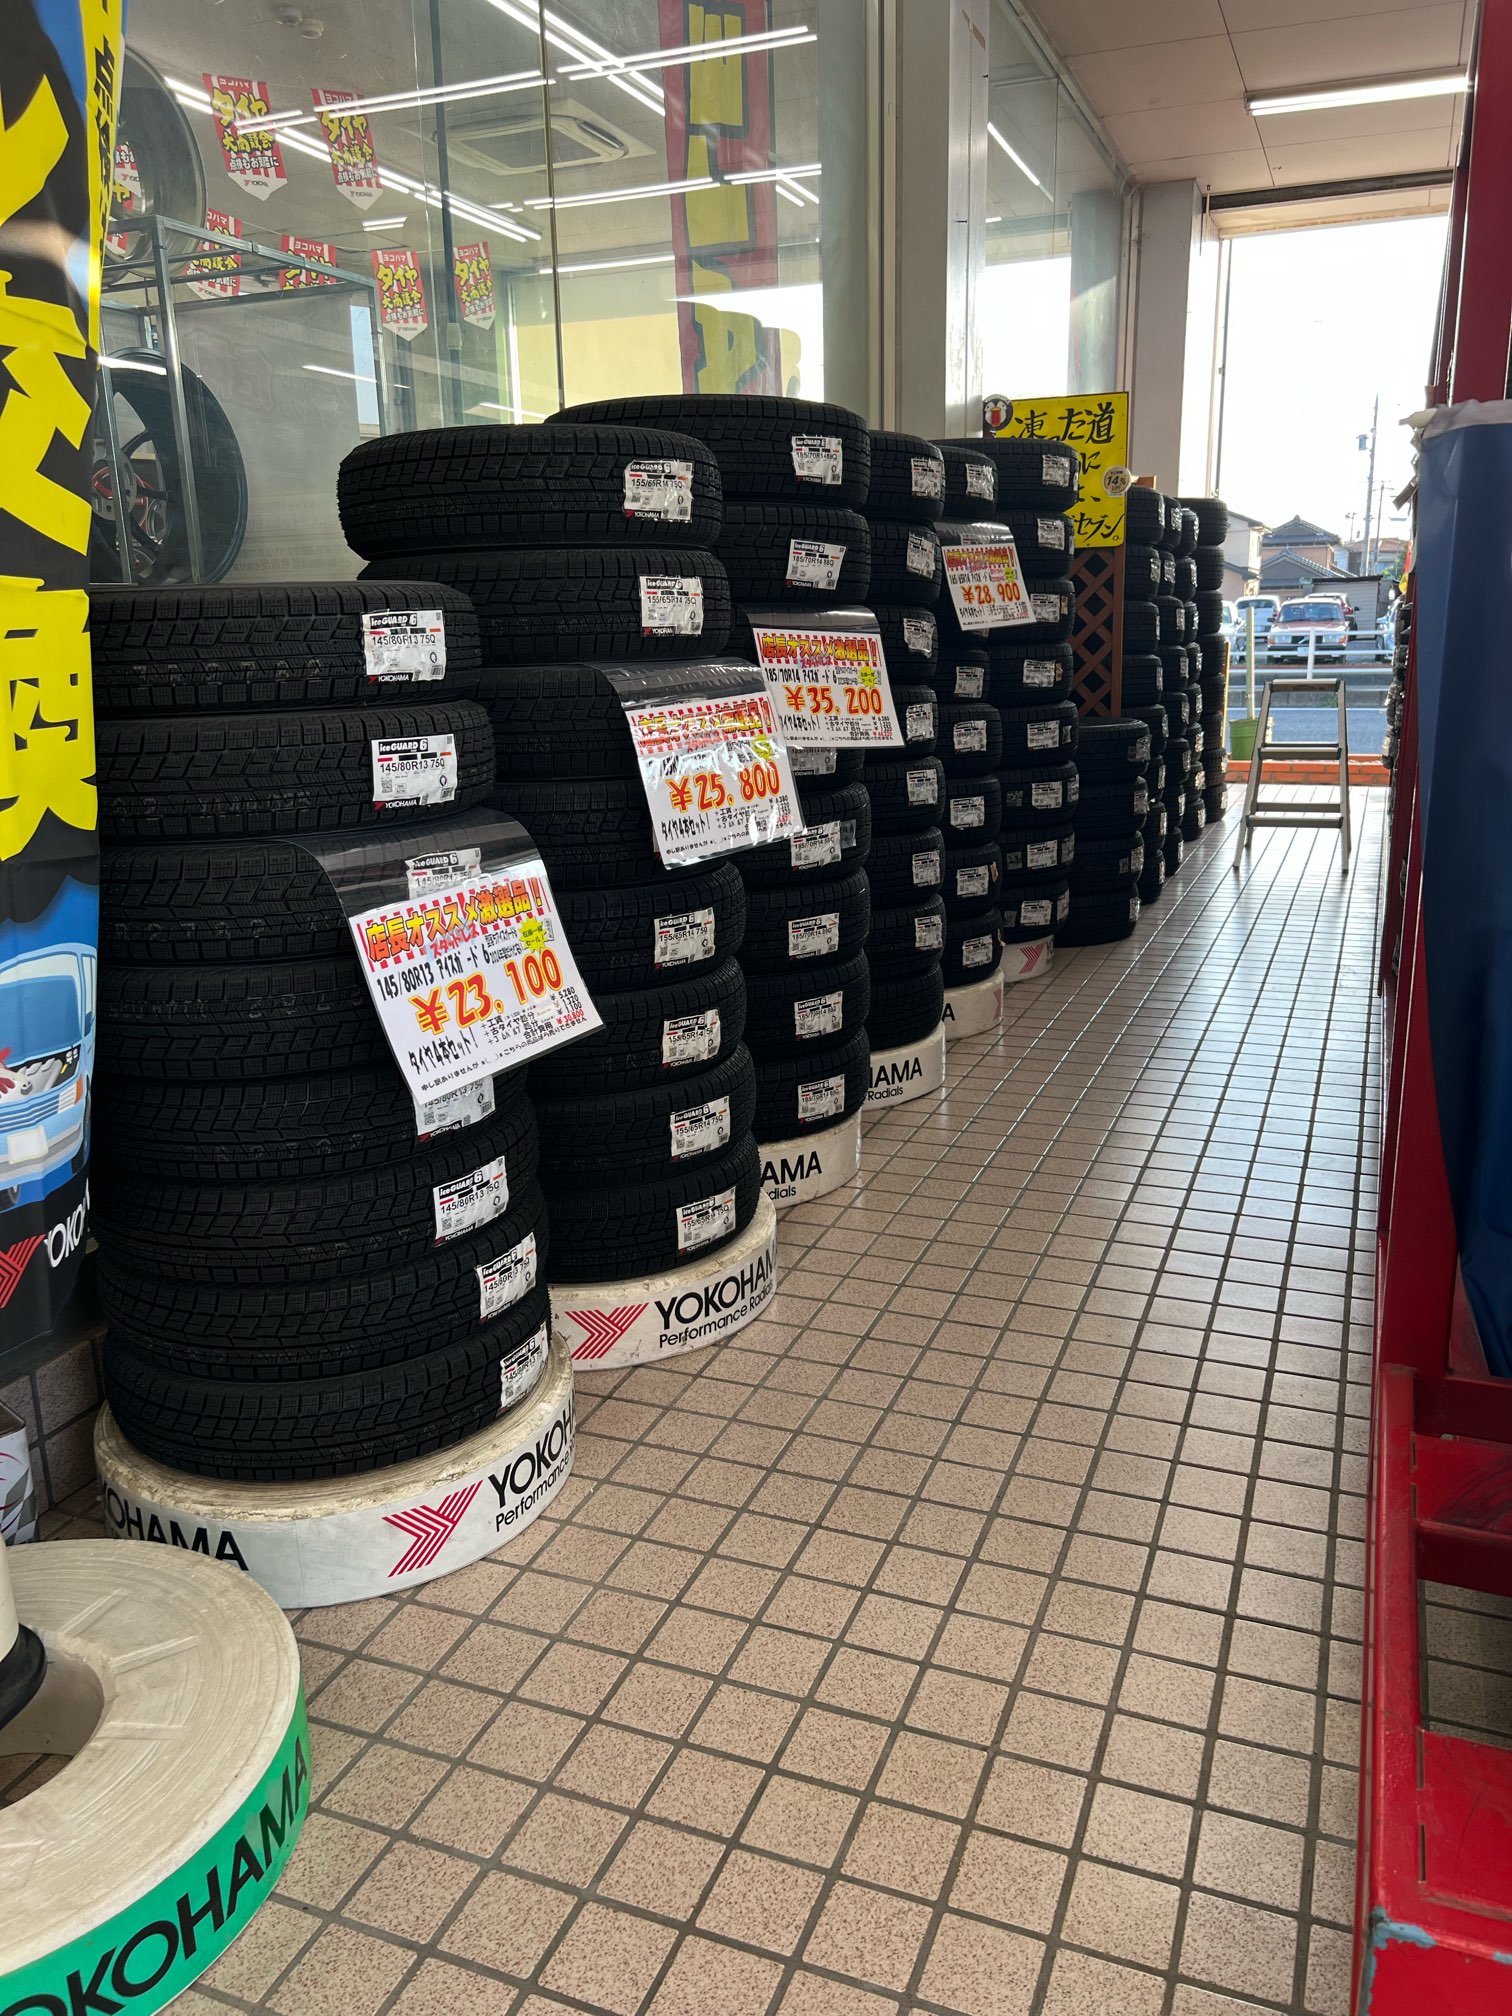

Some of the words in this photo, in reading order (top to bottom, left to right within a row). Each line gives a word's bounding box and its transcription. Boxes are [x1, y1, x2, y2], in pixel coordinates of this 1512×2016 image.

[211, 87, 269, 129] タイヤ
[294, 241, 323, 253] ヨコハマ
[383, 254, 406, 263] ヨコハマ
[376, 263, 419, 292] タイヤ
[454, 256, 490, 287] タイヤ
[371, 615, 408, 627] iceGUARD
[409, 614, 417, 626] 6
[372, 635, 419, 646] 145/80R13
[420, 634, 436, 644] 75Q
[783, 685, 882, 715] ¥35,200
[379, 741, 419, 753] iceGUARD
[420, 739, 428, 751] 6
[380, 760, 429, 773] 145/80R13
[666, 760, 781, 813] ¥25,800
[385, 799, 418, 809] YOKOHAMA
[450, 853, 458, 865] 6
[377, 962, 434, 1001] 145/80R13
[482, 943, 490, 964] 6
[408, 948, 563, 1035] ¥23,100
[867, 1086, 904, 1101] Radials
[474, 1172, 482, 1184] 6
[440, 1190, 485, 1214] 145/80R13
[659, 1304, 748, 1348] Performance
[496, 1450, 569, 1532] Performance
